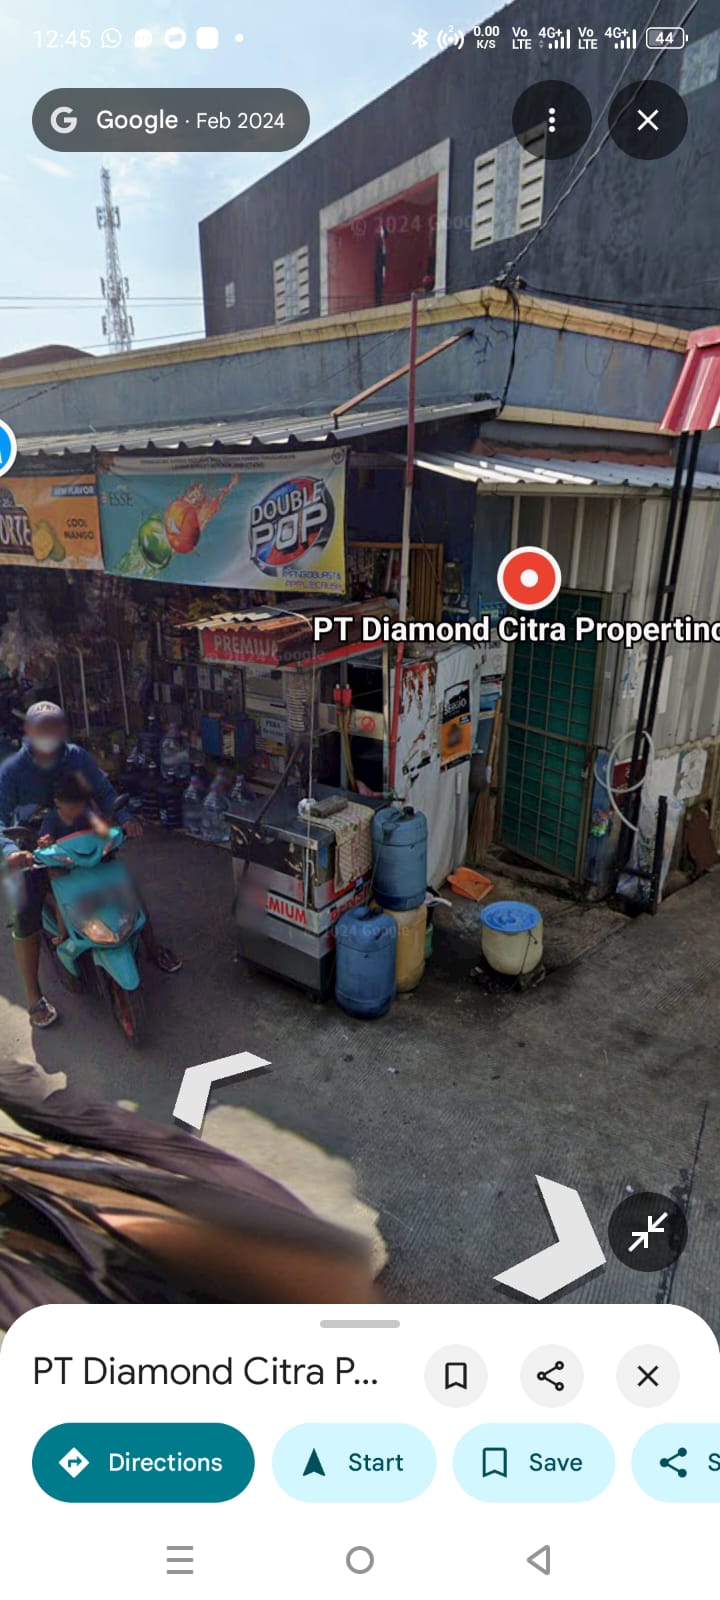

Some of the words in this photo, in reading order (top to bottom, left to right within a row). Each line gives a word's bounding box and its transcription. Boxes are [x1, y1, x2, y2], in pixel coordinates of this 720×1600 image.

[109, 491, 134, 507] ESSE
[252, 483, 325, 524] DOUBLE
[66, 518, 88, 528] COOL
[252, 501, 328, 559] POP
[64, 531, 94, 540] MANGO
